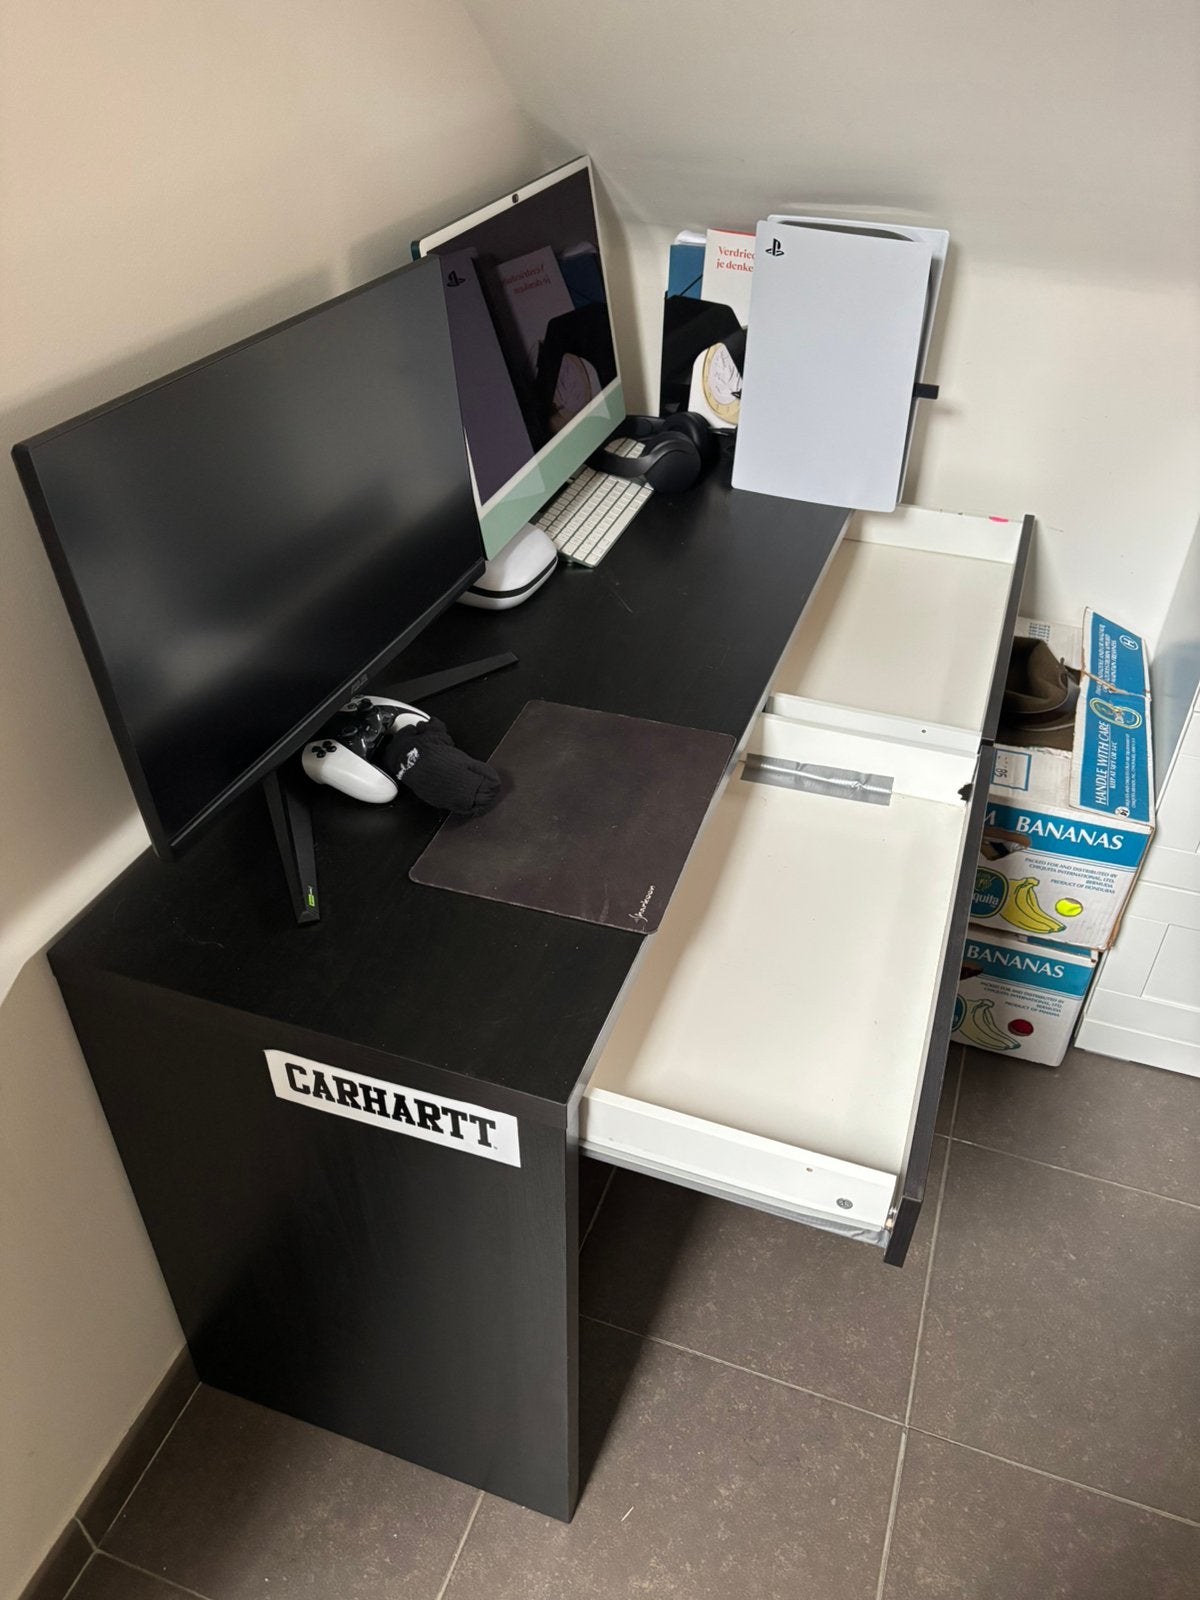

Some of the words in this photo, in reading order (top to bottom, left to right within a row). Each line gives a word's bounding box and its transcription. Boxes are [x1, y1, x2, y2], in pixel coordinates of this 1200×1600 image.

[716, 259, 725, 269] je
[1098, 719, 1109, 742] CARE
[1096, 740, 1108, 768] WITH
[1094, 767, 1107, 805] HANDLE
[1016, 816, 1124, 850] BANANAS
[1050, 879, 1076, 887] PRODUCT
[1073, 866, 1109, 876] DISTRIBUTED
[967, 945, 1065, 978] BANANAS
[285, 1062, 497, 1148] CARHARTT
